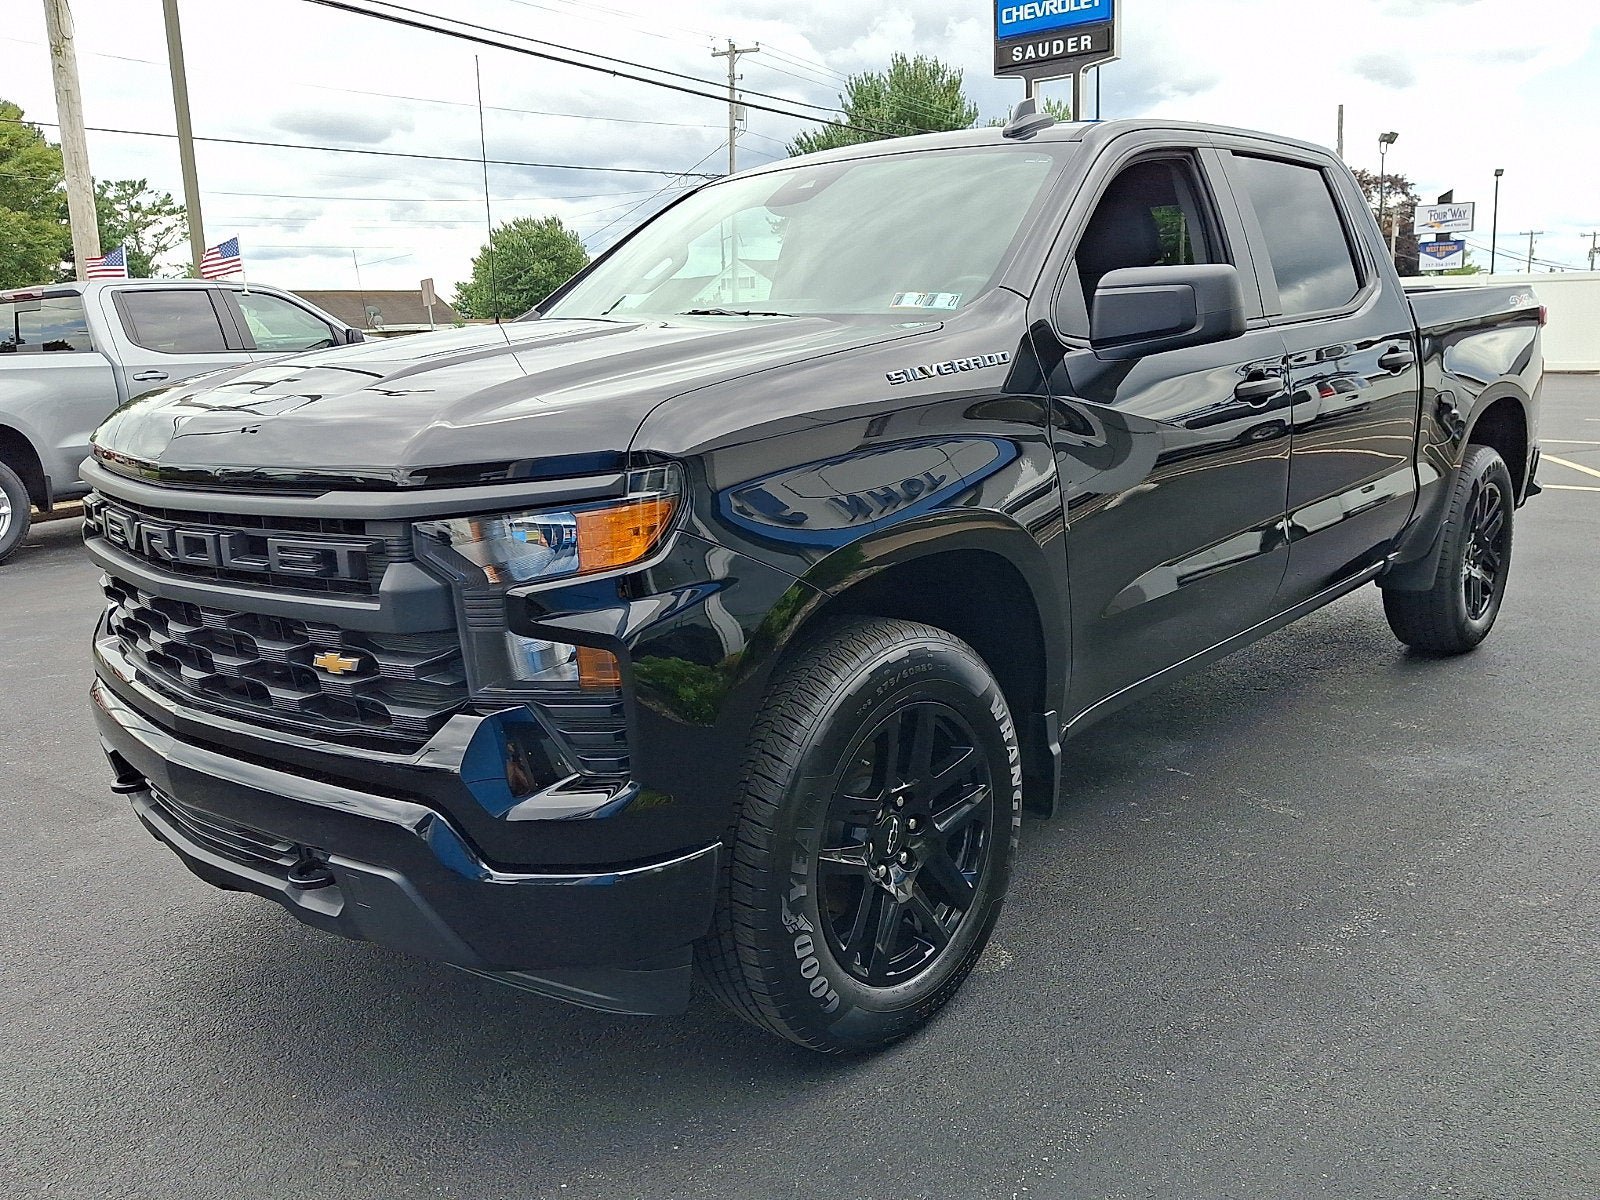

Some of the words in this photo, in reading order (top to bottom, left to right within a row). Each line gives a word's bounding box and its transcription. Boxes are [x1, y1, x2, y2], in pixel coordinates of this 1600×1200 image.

[1012, 35, 1092, 62] SAUDER
[1428, 209, 1448, 221] FOUR
[1448, 207, 1467, 219] WAY
[886, 352, 1010, 385] SILVERADO
[989, 693, 1022, 849] WRANGL
[781, 832, 840, 1015] GOODYE
